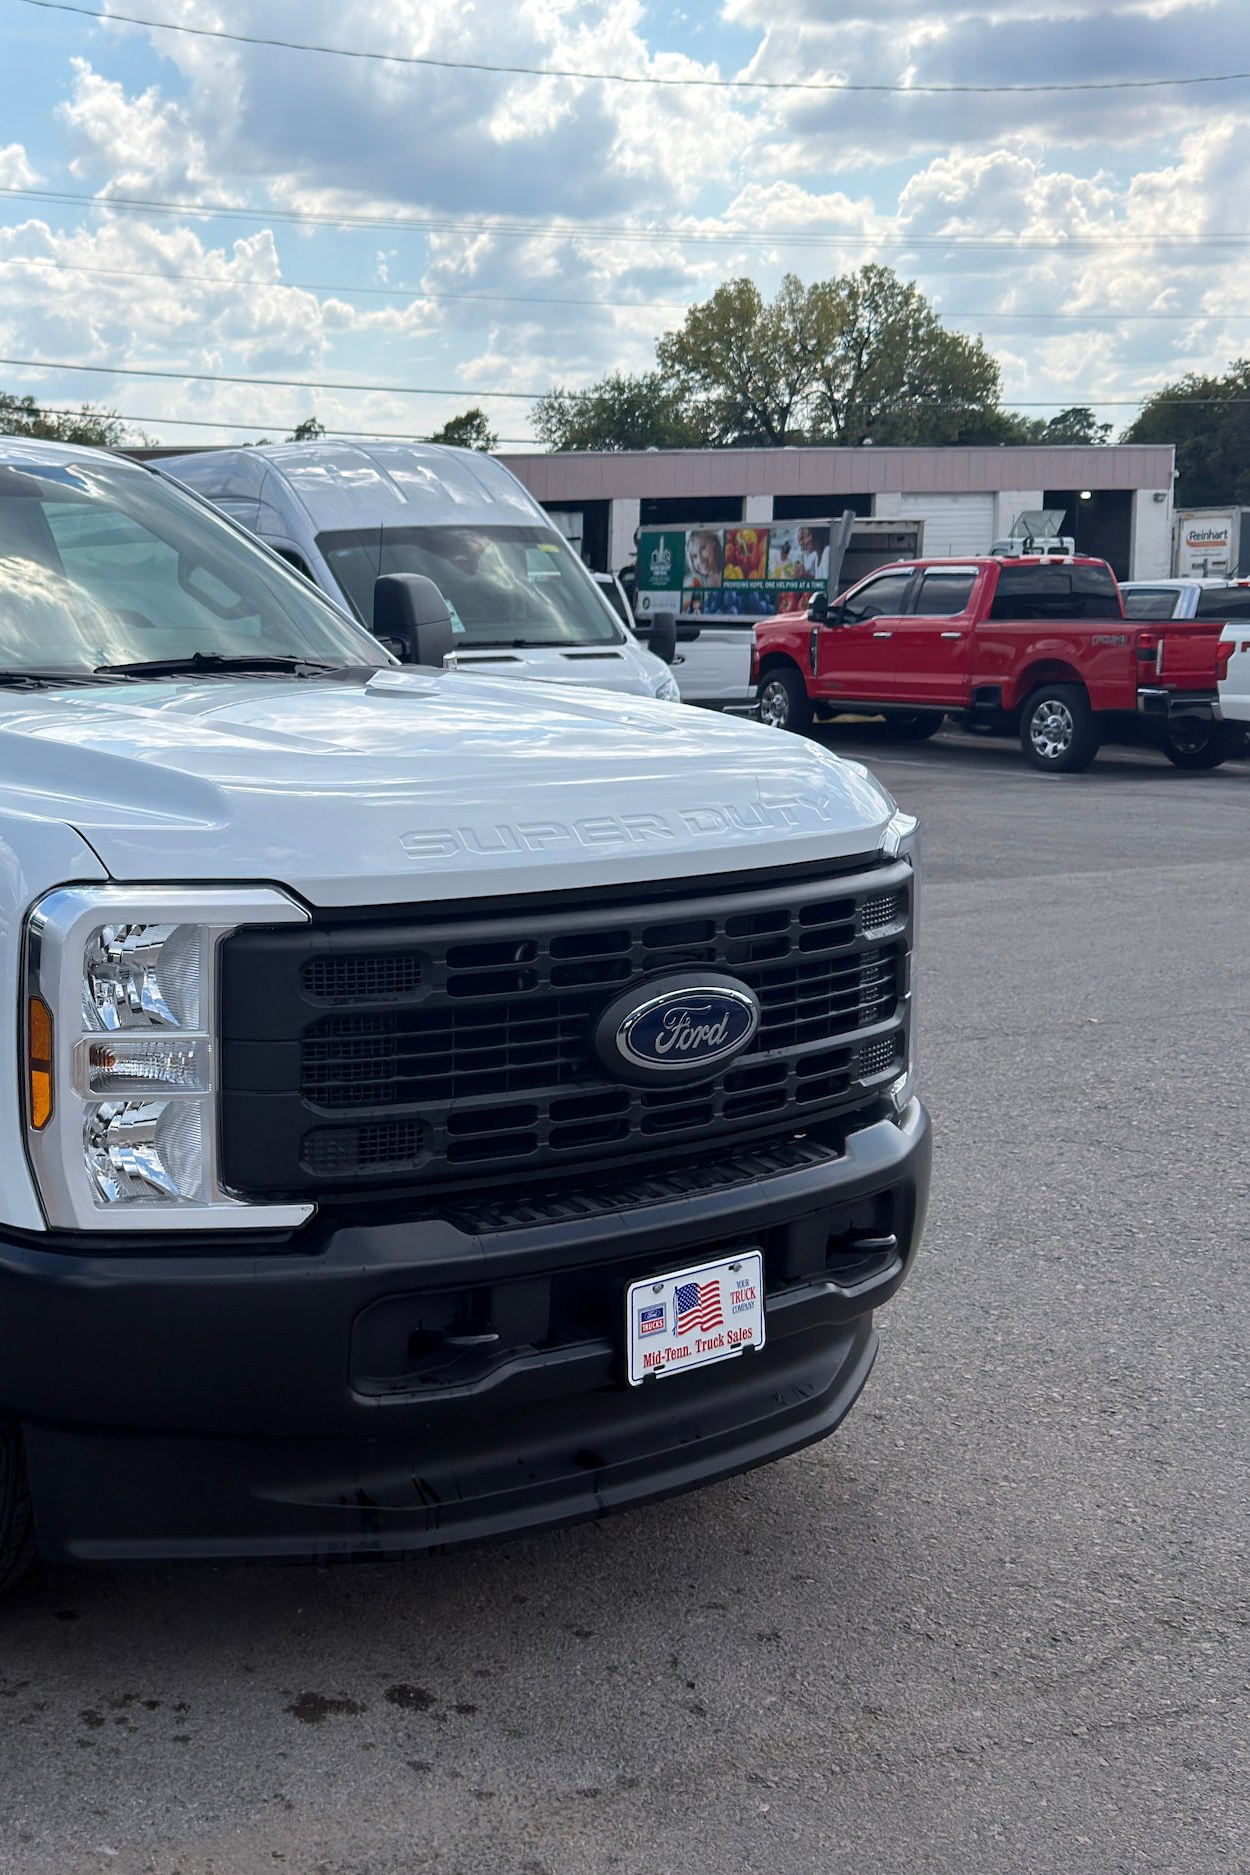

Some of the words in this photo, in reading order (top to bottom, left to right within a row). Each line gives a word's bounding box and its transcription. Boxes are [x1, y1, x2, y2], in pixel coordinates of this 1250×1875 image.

[1189, 528, 1228, 541] Reinhart
[722, 581, 749, 589] PROVIDING
[750, 581, 764, 589] HOPE,
[765, 581, 775, 589] ONE
[776, 581, 798, 589] HELPING
[799, 581, 806, 589] AT
[811, 581, 824, 589] TIME.
[398, 813, 674, 860] SUPER
[678, 795, 835, 837] DUTY
[654, 1004, 730, 1054] Ford
[736, 1279, 750, 1289] YOUR
[730, 1286, 756, 1305] TRUCK
[732, 1301, 755, 1314] COMPANY
[642, 1319, 663, 1333] TRUCKS
[643, 1345, 692, 1368] Mid-Tenn.
[695, 1333, 725, 1353] Truck
[727, 1326, 753, 1345] Sales
